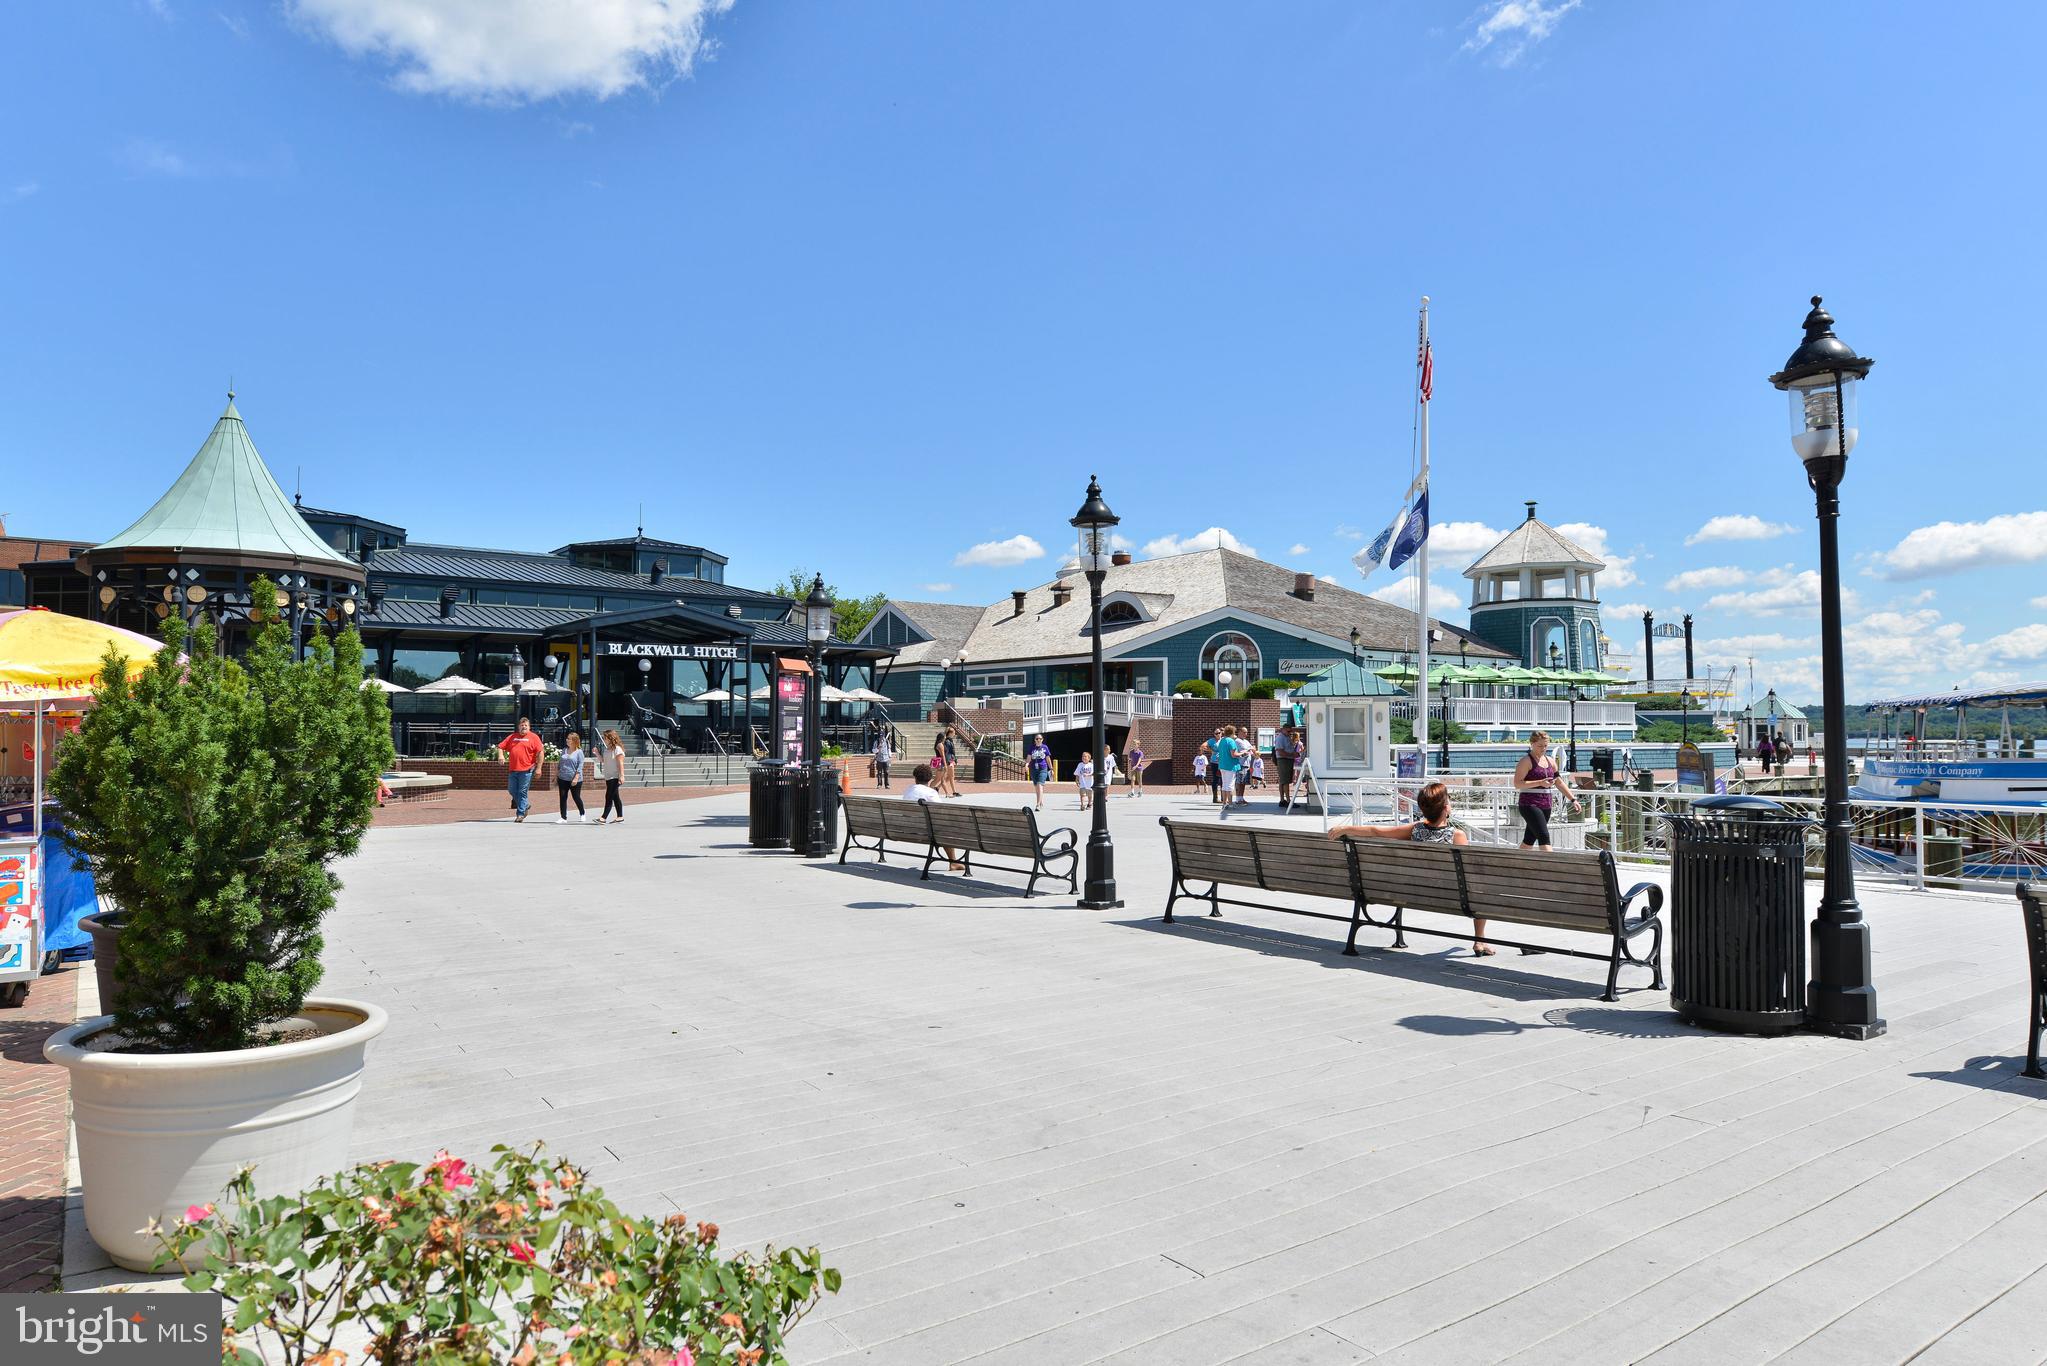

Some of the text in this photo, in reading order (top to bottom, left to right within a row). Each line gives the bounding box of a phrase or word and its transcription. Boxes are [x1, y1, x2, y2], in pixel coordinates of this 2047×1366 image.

[608, 643, 738, 658] BLACKWALL HITCH
[0, 680, 51, 695] Tasty
[56, 676, 84, 691] Ice
[1898, 764, 1936, 775] Riverboat
[1938, 765, 1984, 778] Company
